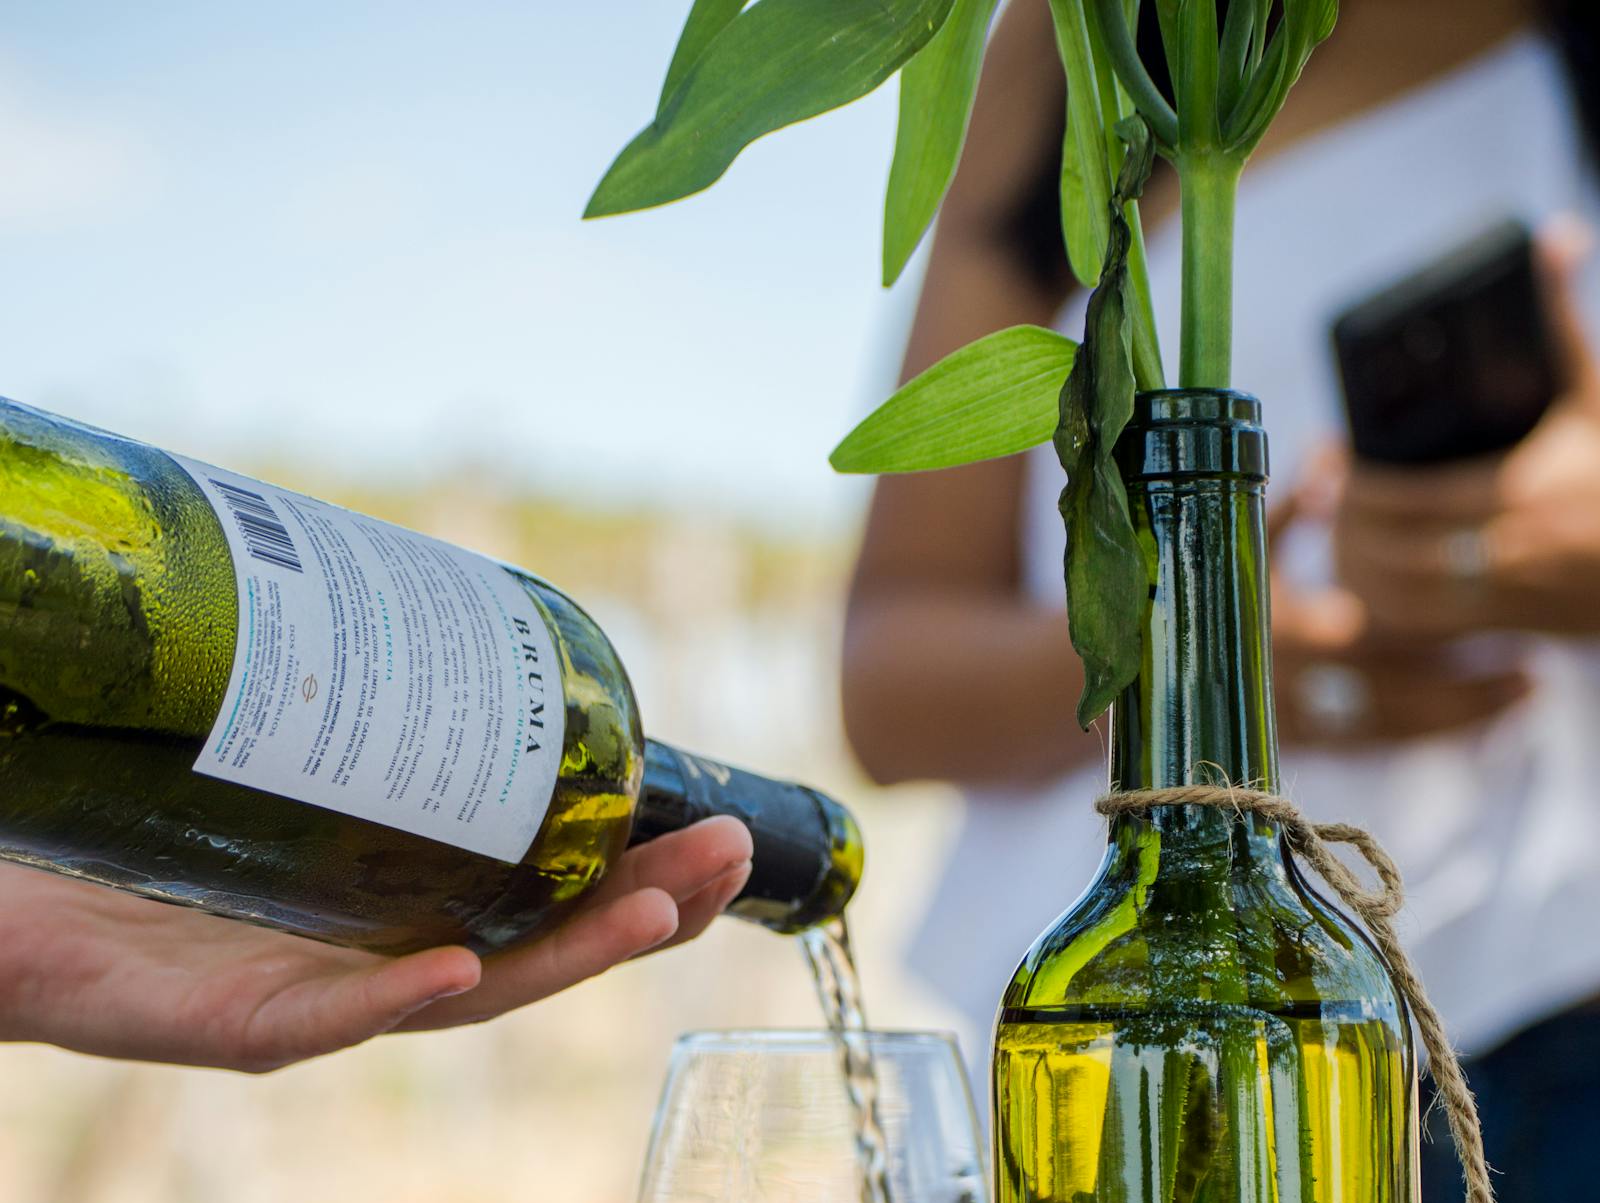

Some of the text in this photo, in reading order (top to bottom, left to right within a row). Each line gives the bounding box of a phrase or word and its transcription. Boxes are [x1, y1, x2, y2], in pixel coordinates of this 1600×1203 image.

[342, 555, 359, 586] OPERAR
[335, 555, 354, 597] PERJUDICA
[350, 606, 358, 618] SU
[367, 606, 376, 619] DE
[288, 623, 296, 650] DOS
[376, 590, 393, 681] ADVERTENCIA
[402, 610, 413, 647] algunas
[332, 631, 340, 672] Mantener
[362, 650, 370, 681] PUEDE
[417, 643, 425, 669] suelo
[442, 643, 451, 666] cada
[450, 647, 459, 685] aporten
[457, 631, 470, 685] balanceada
[331, 672, 337, 684] en
[338, 652, 347, 692] PROHIBIDA
[426, 649, 434, 702] Sauvignon
[511, 646, 524, 688] BLANC
[369, 669, 379, 700] LIMITA
[405, 676, 416, 713] cítricas
[416, 672, 424, 711] aportan
[453, 690, 459, 703] en
[462, 689, 470, 703] de
[512, 617, 545, 753] BRUMA
[264, 694, 273, 708] DEL
[322, 684, 336, 723] ambiente
[356, 682, 368, 718] CAUSAR
[366, 705, 374, 718] SU
[460, 707, 469, 722] las
[487, 695, 495, 711] del
[255, 711, 268, 736] MORRO
[327, 700, 341, 734] MENORES
[422, 704, 433, 730] Blanc
[451, 709, 457, 722] su
[494, 716, 504, 742] largo
[313, 724, 328, 749] fresco
[322, 735, 331, 747] DE
[345, 719, 361, 754] GRAVES
[348, 721, 370, 771] CAPACIDAD
[406, 715, 419, 752] aromas
[445, 725, 456, 751] justa
[451, 727, 465, 766] mejores
[231, 737, 251, 767] ECUADOR
[237, 751, 251, 769] PARA
[302, 755, 314, 773] seco.
[383, 724, 408, 782] refrescantes.
[498, 709, 524, 805] CHARDONNAY
[331, 755, 349, 784] DAÑOS
[339, 774, 351, 787] DE
[385, 755, 410, 800] tropicales
[394, 743, 424, 802] Chardonnay,
[430, 756, 448, 792] medida
[472, 754, 486, 786] crecen
[421, 797, 433, 811] las
[431, 801, 440, 814] de
[467, 786, 476, 799] en
[456, 800, 471, 821] total
[465, 799, 483, 824] hasta
